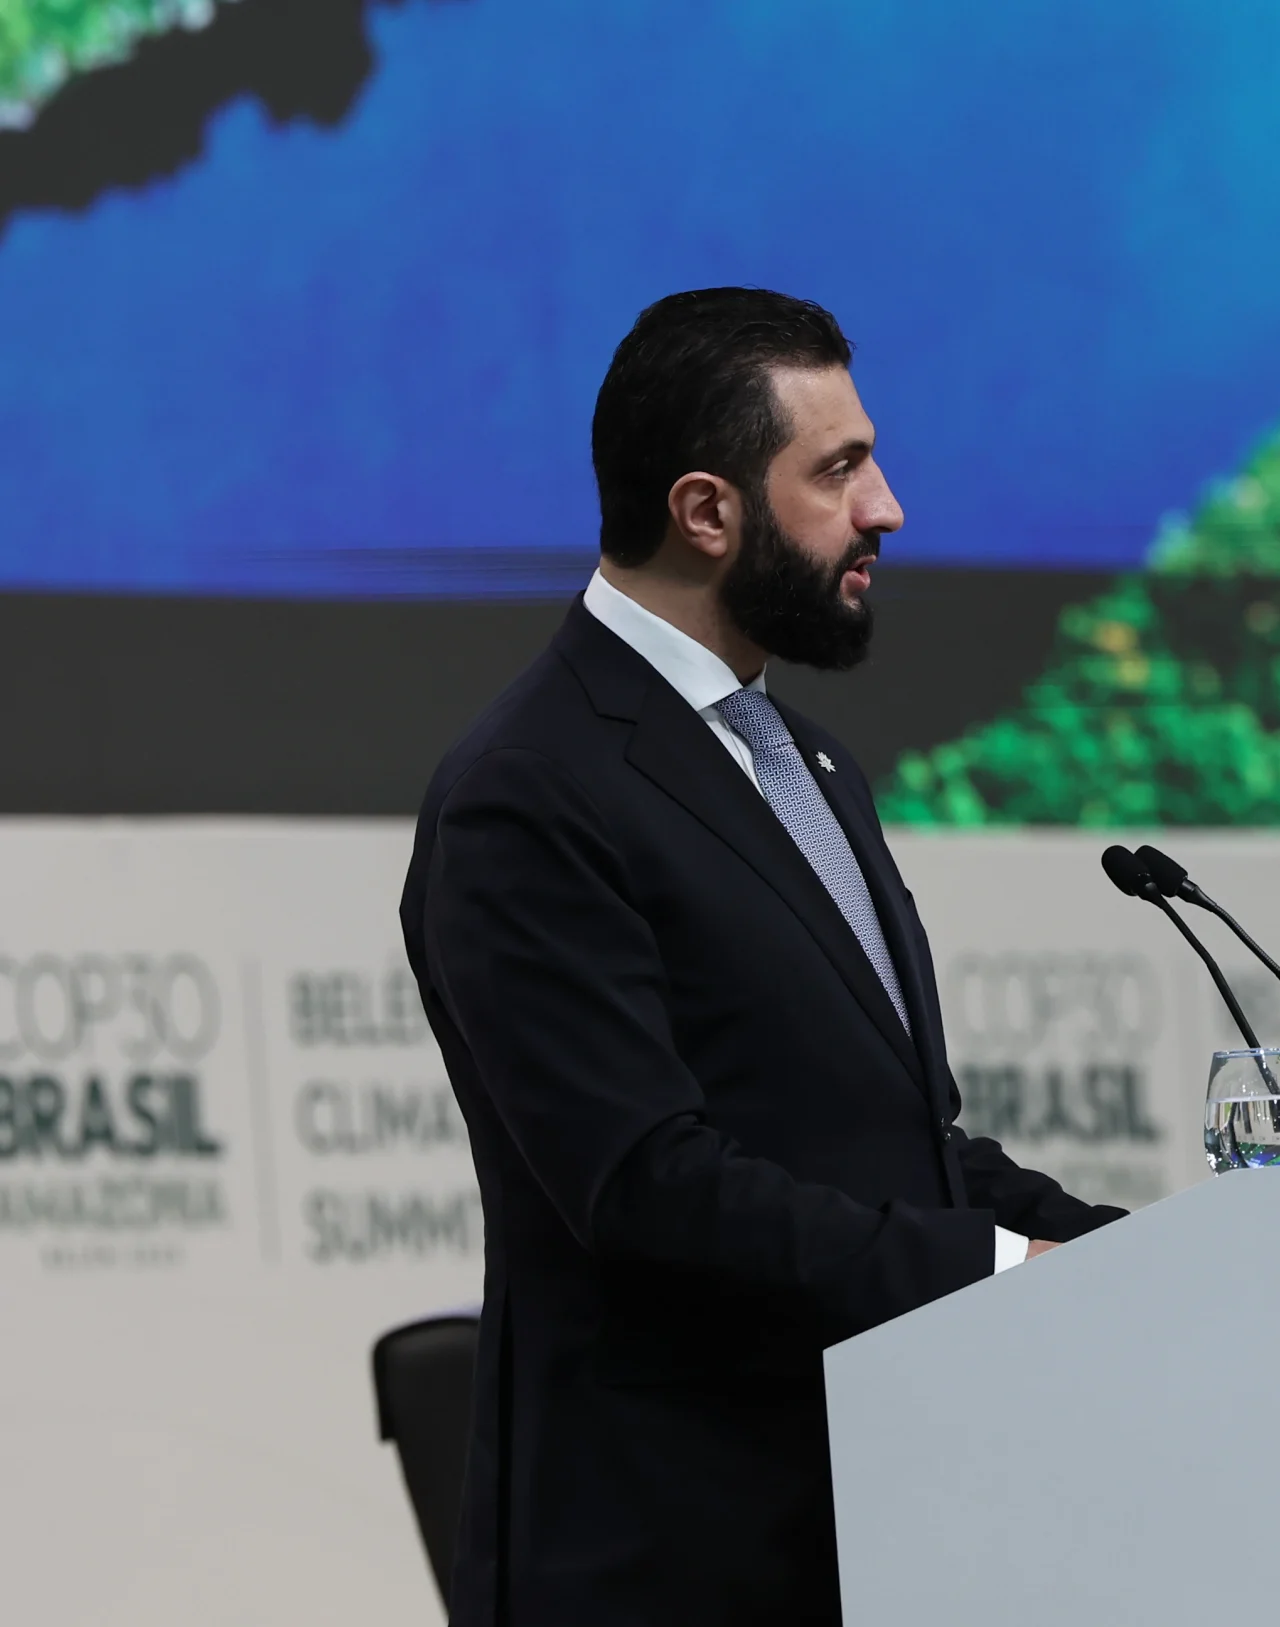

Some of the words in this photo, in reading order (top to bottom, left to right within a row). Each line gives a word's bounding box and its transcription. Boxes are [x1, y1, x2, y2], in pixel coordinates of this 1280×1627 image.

[288, 950, 432, 1048] BELÉ
[294, 1080, 467, 1152] CLIMA
[303, 1190, 482, 1262] SUMM
